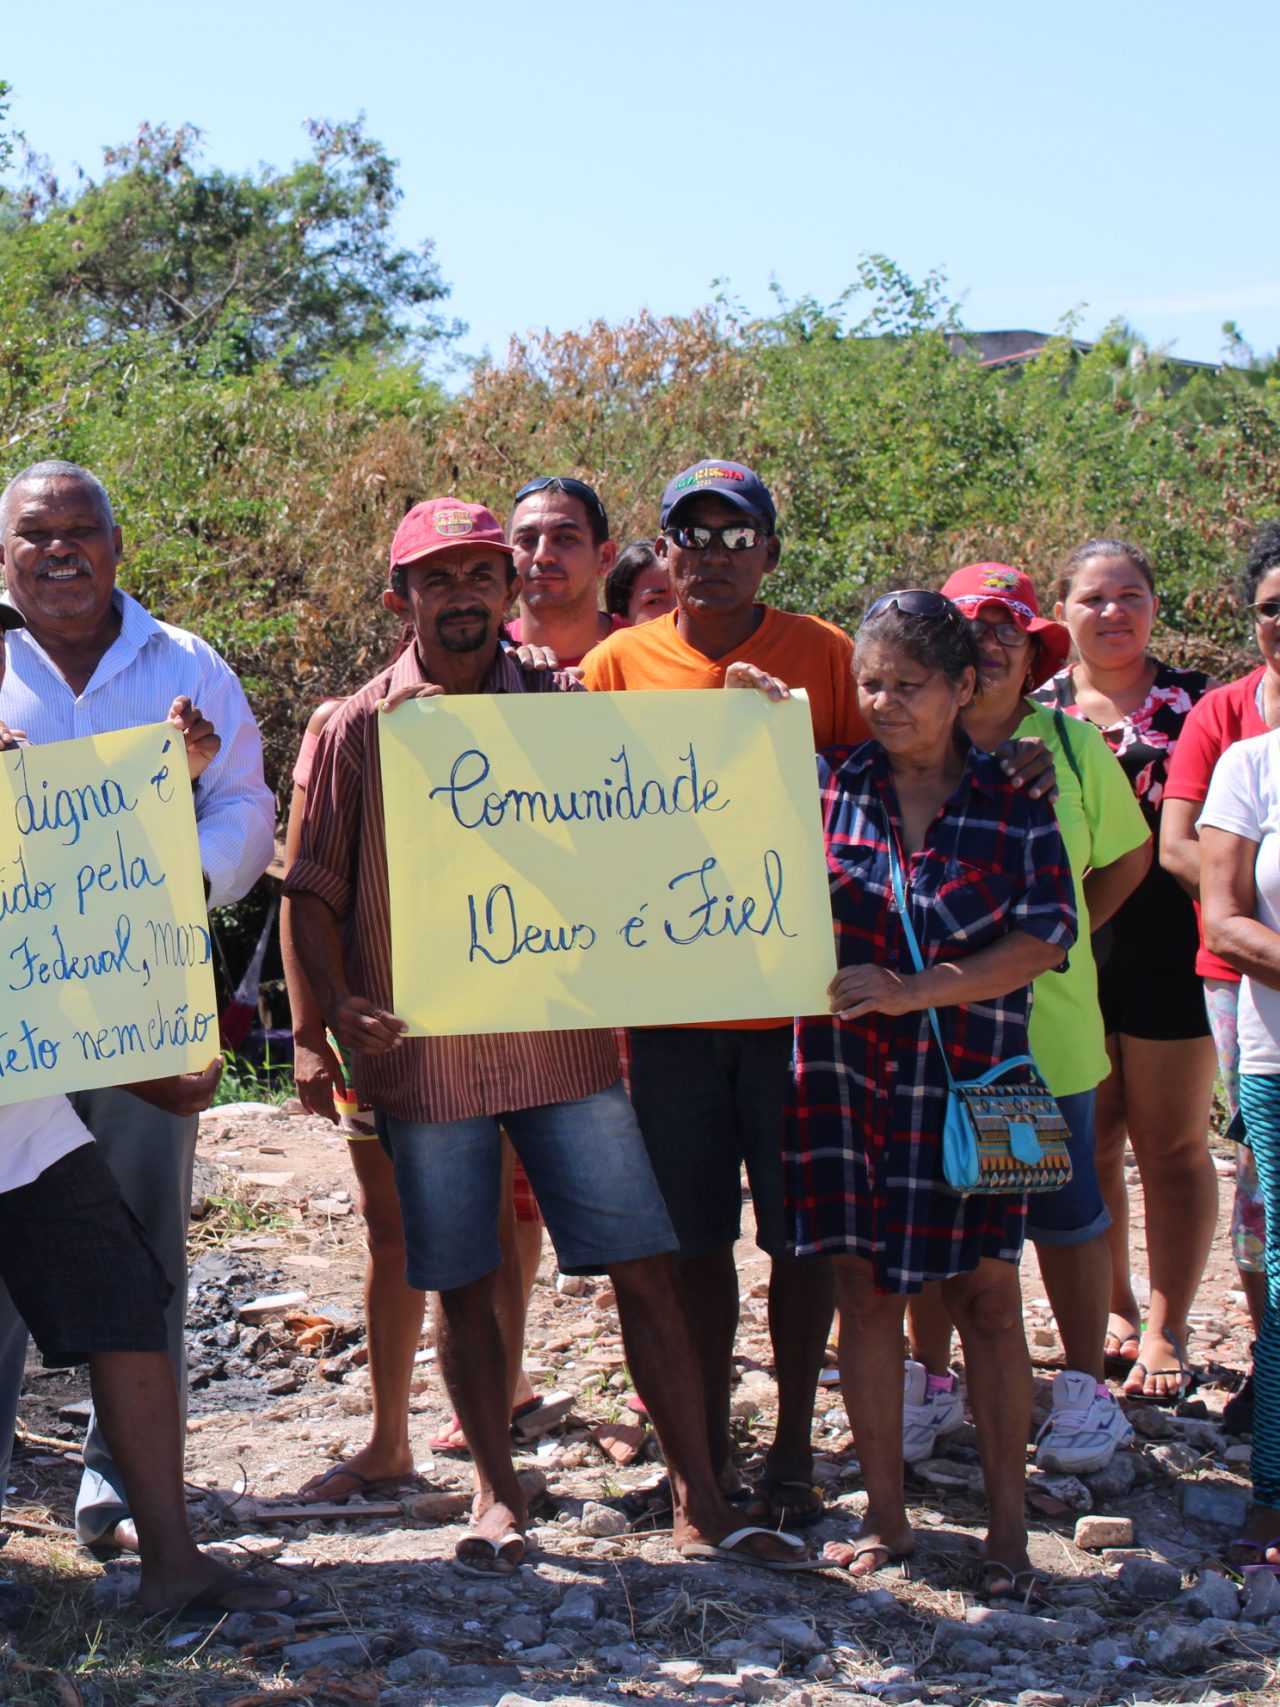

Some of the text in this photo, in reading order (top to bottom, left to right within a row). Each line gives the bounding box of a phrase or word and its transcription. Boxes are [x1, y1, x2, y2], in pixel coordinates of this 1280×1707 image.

[14, 750, 138, 846] digna
[151, 739, 176, 803] é
[429, 743, 731, 828] Comunidade
[77, 831, 166, 915] pela
[467, 850, 799, 964] Deus é Fiel
[73, 1023, 145, 1061] nem
[148, 1000, 216, 1050] chão
